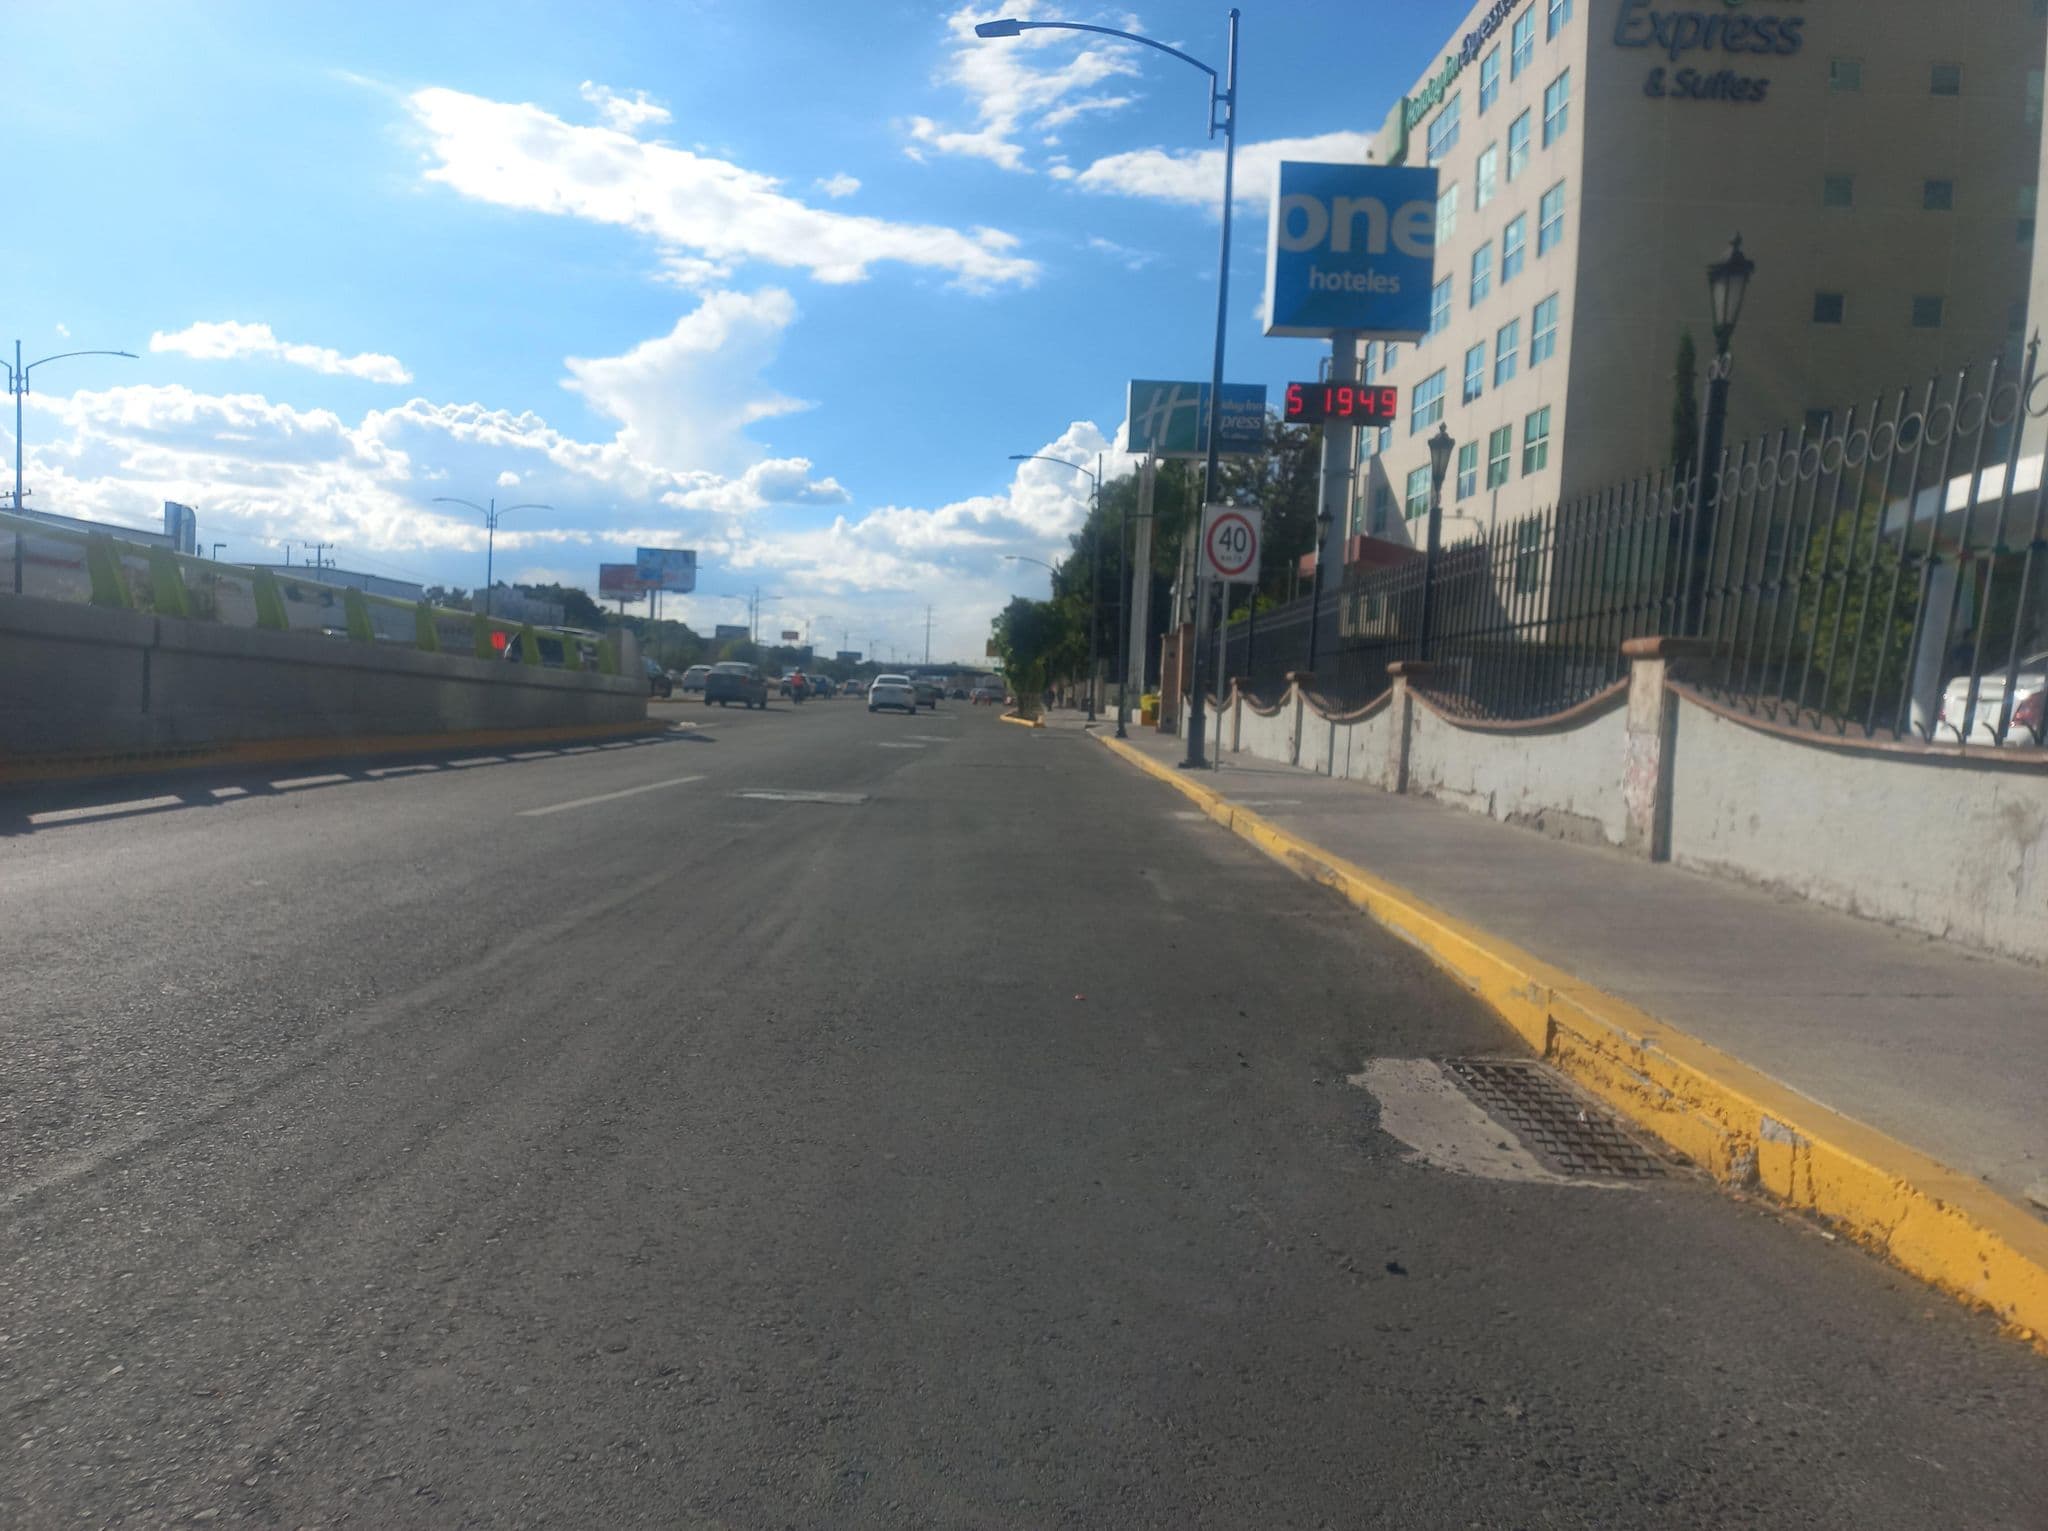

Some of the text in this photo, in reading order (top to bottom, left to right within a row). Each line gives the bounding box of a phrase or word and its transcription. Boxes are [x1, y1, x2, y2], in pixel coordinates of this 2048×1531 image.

[1614, 0, 1805, 61] Express
[1670, 67, 1770, 102] Suites
[1279, 194, 1434, 258] one
[1310, 266, 1400, 294] hoteles
[1324, 387, 1396, 417] 1949
[1219, 525, 1246, 552] 40
